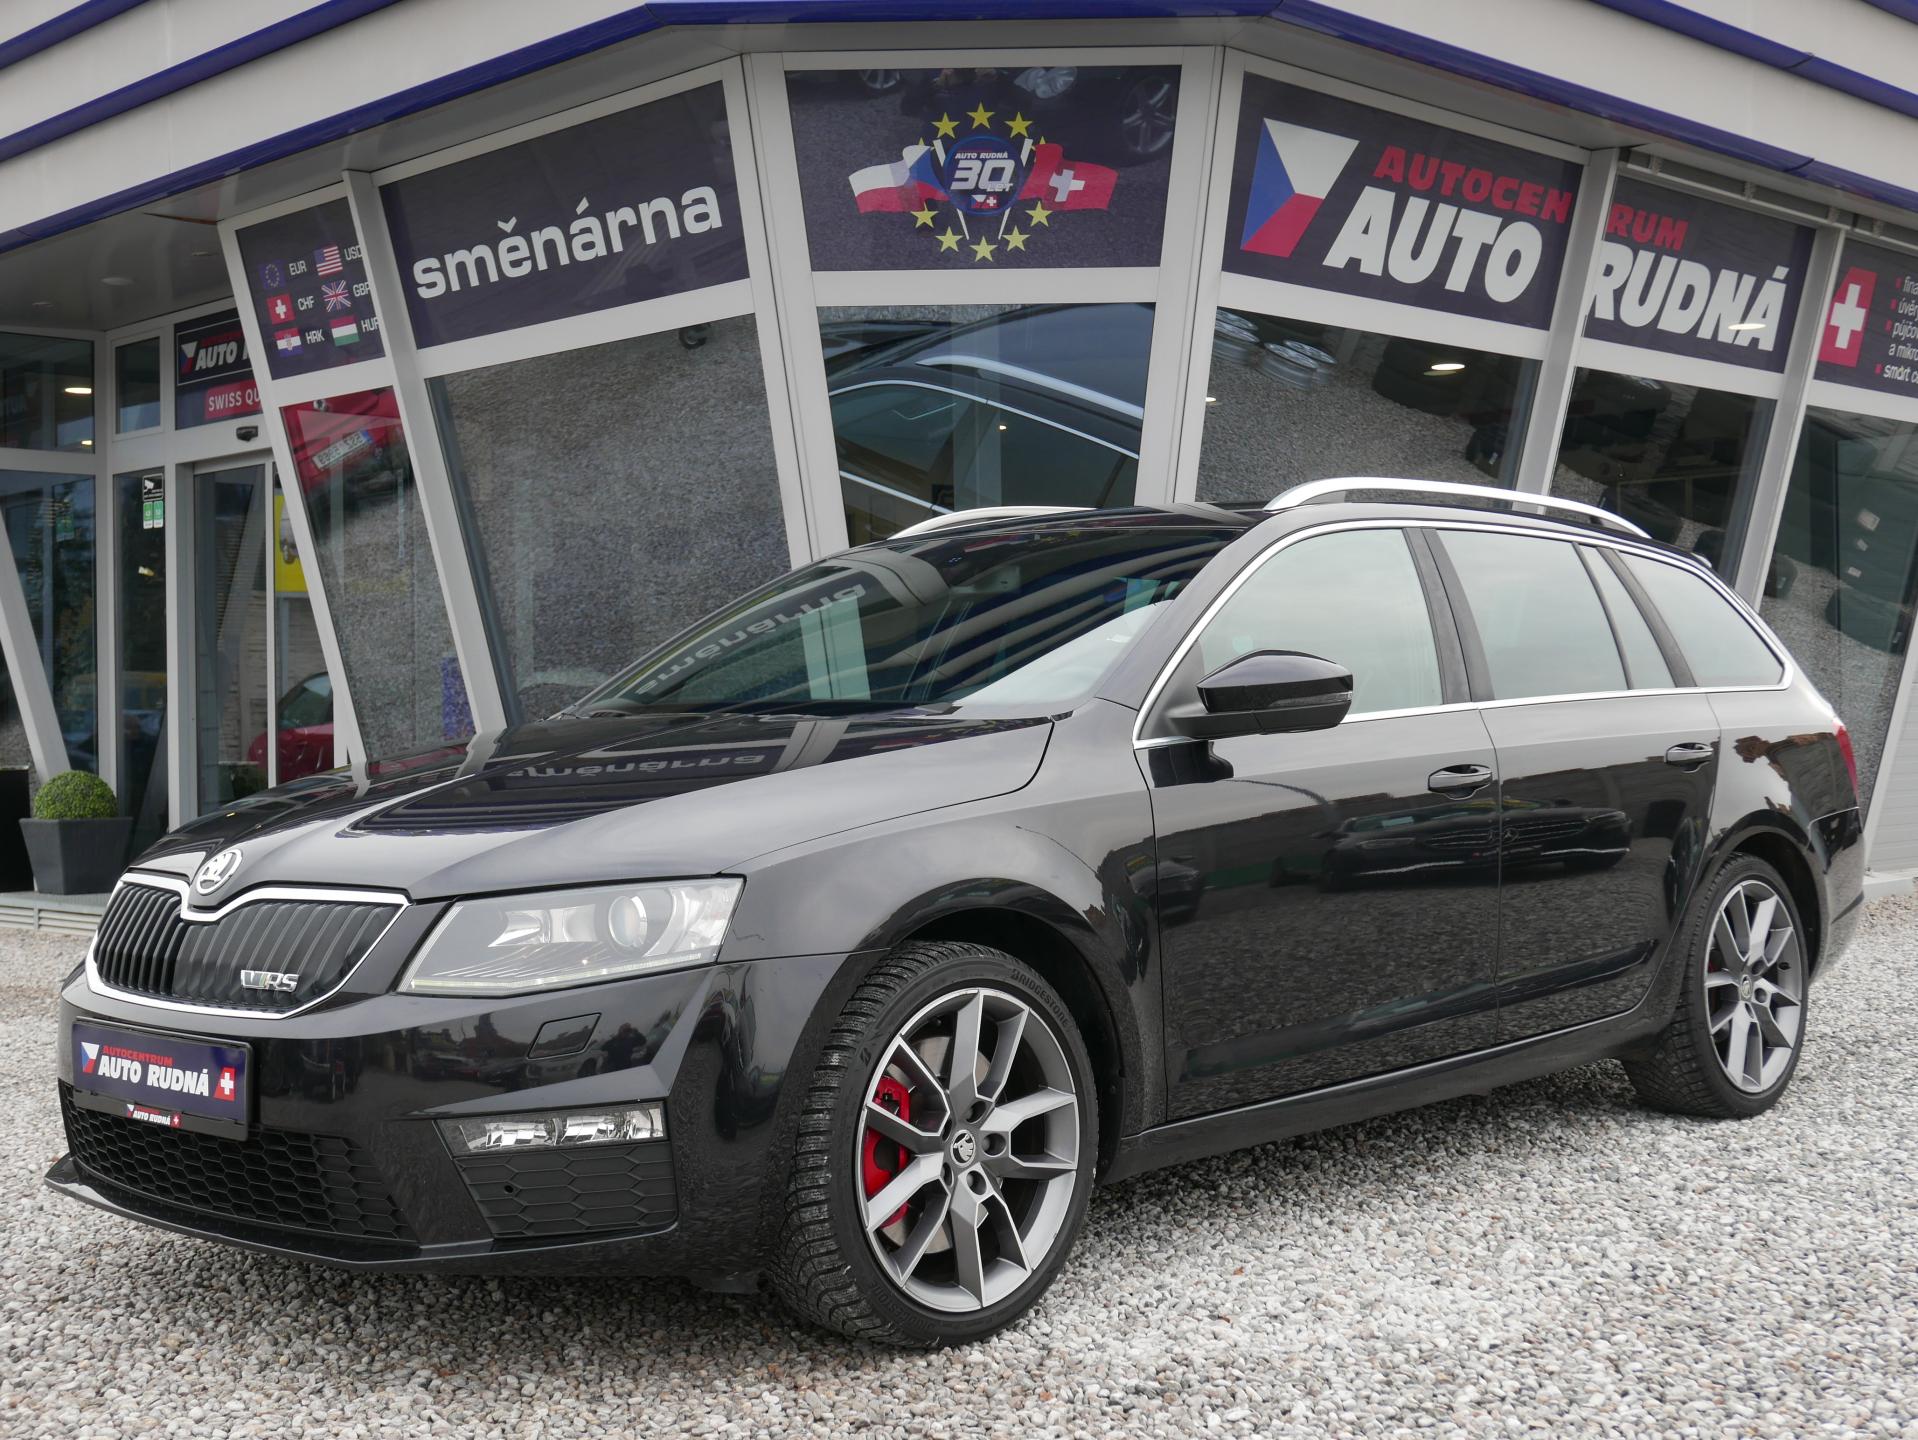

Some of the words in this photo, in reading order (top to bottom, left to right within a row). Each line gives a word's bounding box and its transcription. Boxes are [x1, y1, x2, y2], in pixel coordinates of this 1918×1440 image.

[950, 159, 1015, 190] 30
[412, 186, 723, 299] směnárna
[344, 245, 362, 261] USD
[288, 260, 307, 276] EUR
[1322, 186, 1543, 303] AUTO
[1584, 240, 1790, 352] RUDNÁ
[297, 296, 315, 311] CHF
[305, 329, 325, 344] HRK
[195, 341, 238, 371] AUTO
[1888, 343, 1896, 356] a
[208, 391, 242, 411] SWISS
[102, 1045, 173, 1067] AUTOCENTRUM
[98, 1055, 142, 1084] AUTO
[147, 1064, 209, 1097] RUDNÁ
[132, 1110, 149, 1121] AUTO
